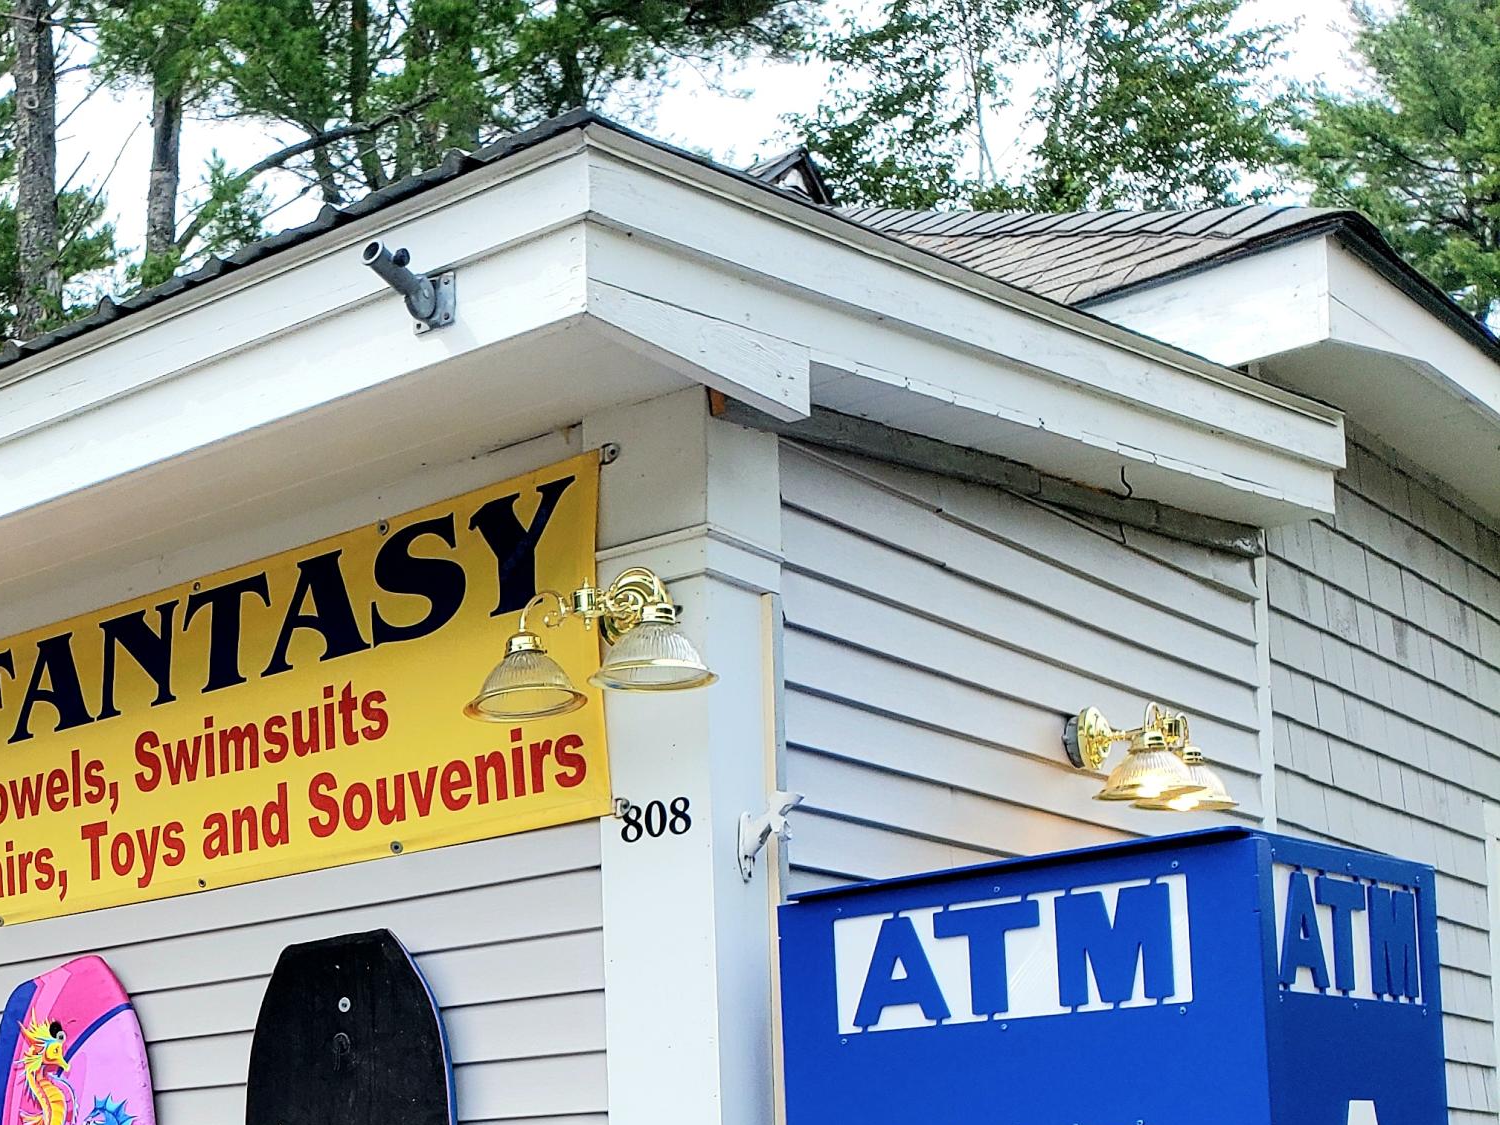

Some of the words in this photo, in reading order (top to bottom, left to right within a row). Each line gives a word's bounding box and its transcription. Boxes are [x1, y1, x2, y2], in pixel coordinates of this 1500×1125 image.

[133, 681, 389, 793] Swimsuits
[80, 820, 187, 889] Toys
[202, 782, 289, 861] and
[307, 727, 588, 839] Souvenirs
[620, 796, 693, 844] 808
[852, 878, 1177, 1030] ATM
[1278, 869, 1422, 1003] ATM
